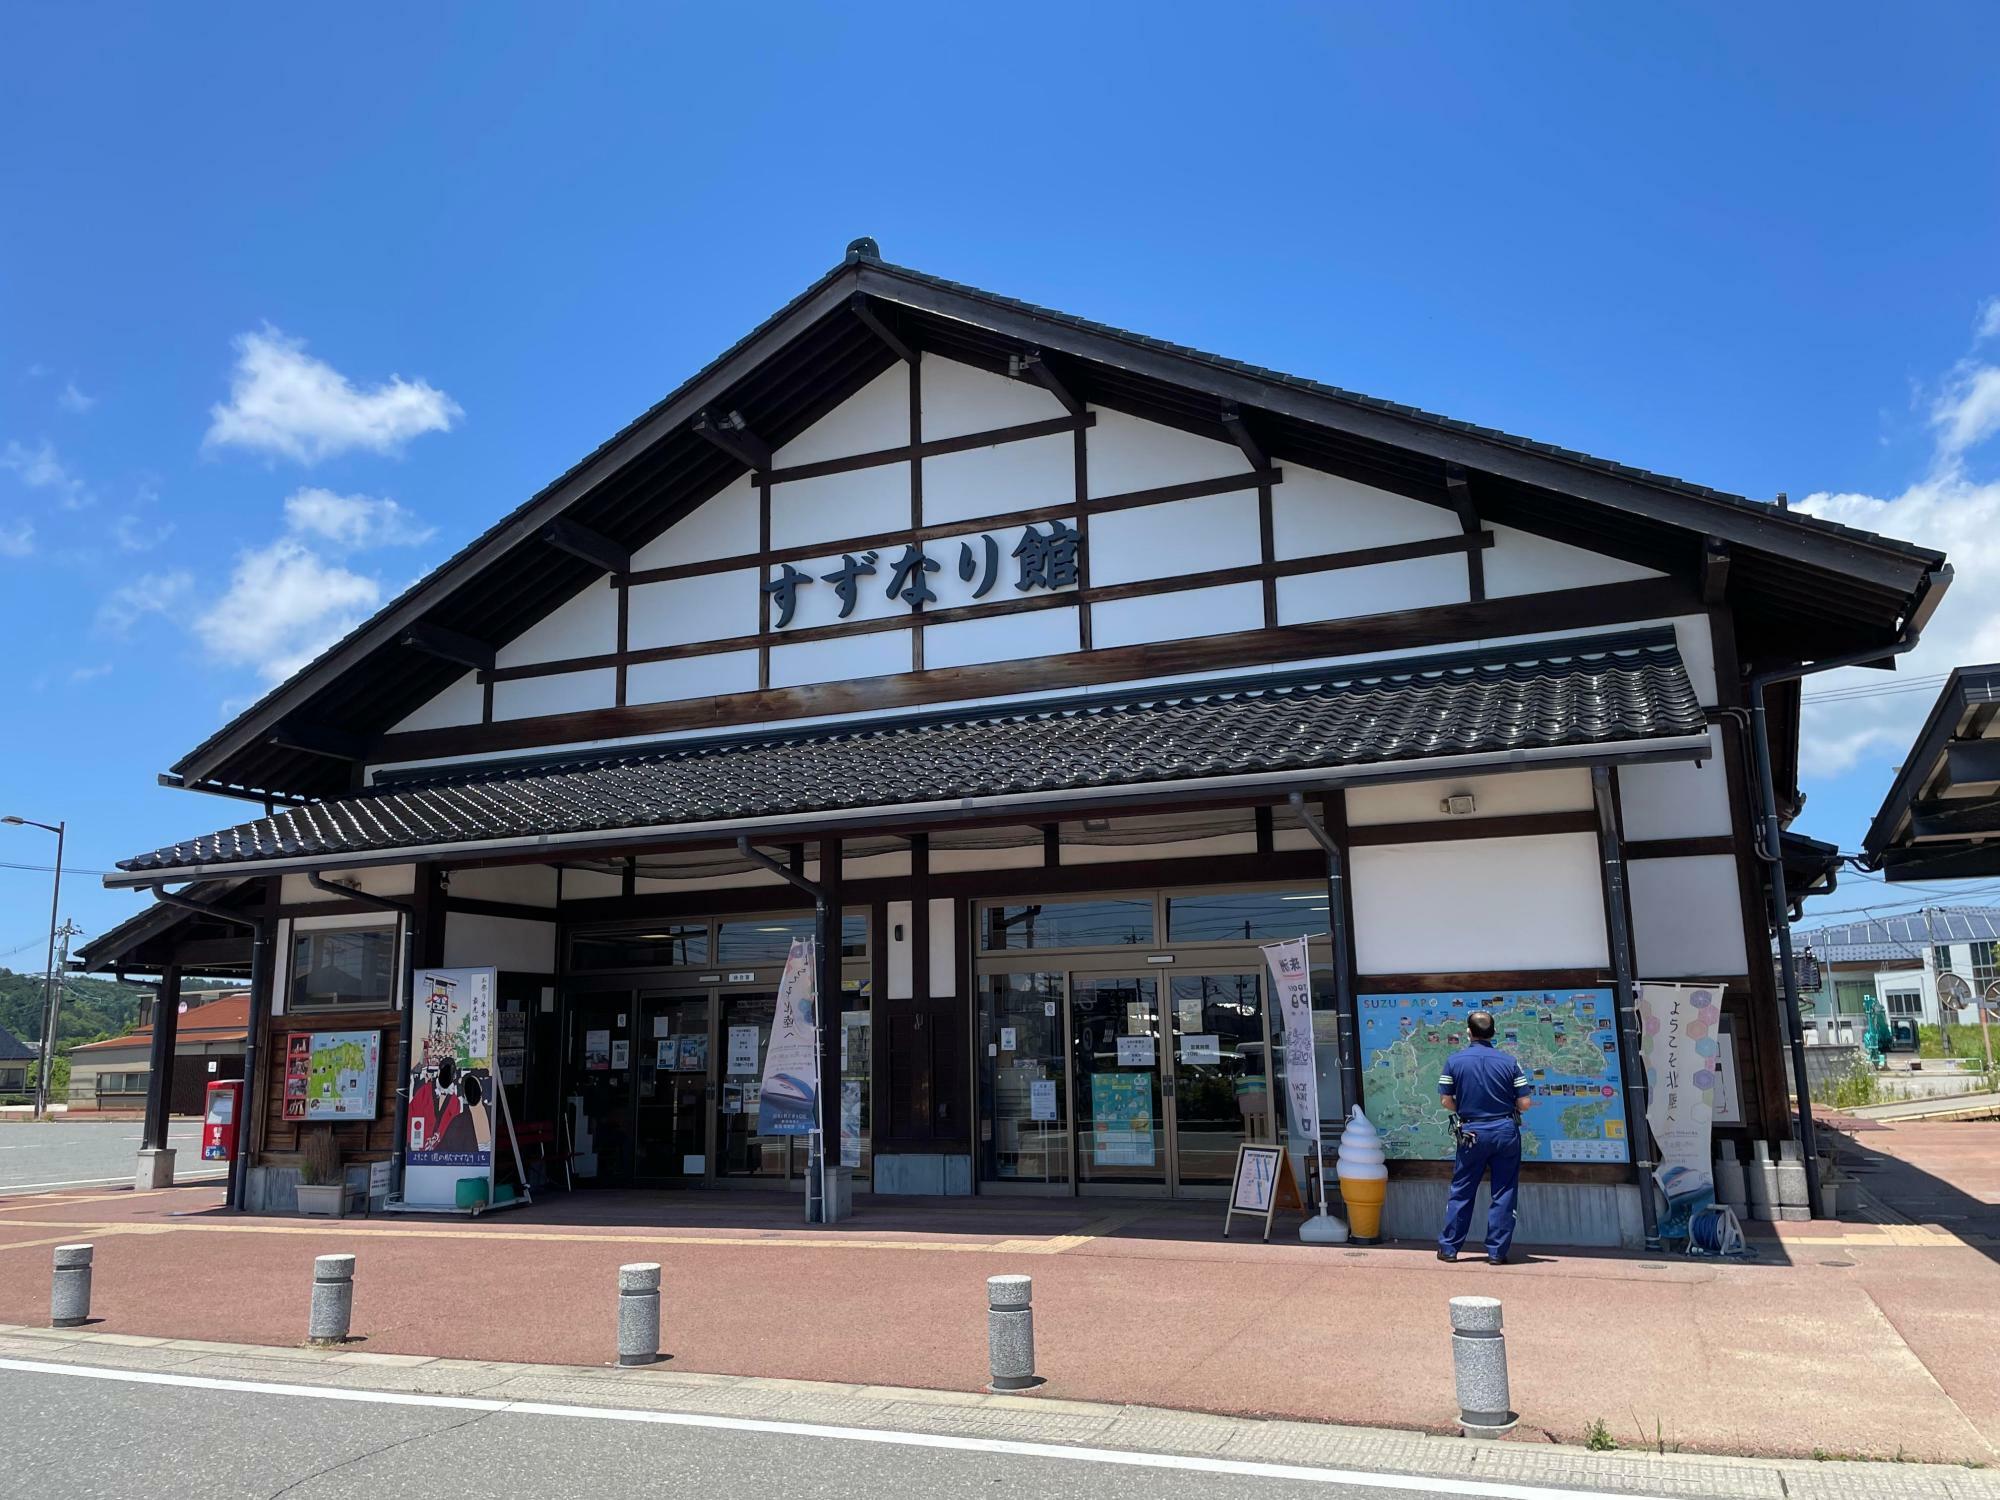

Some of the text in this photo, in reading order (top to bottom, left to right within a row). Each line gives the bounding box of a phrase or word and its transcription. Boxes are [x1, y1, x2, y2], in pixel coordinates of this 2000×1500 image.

[763, 519, 1082, 628] すずなり館
[1363, 999, 1427, 1009] SUZU AP
